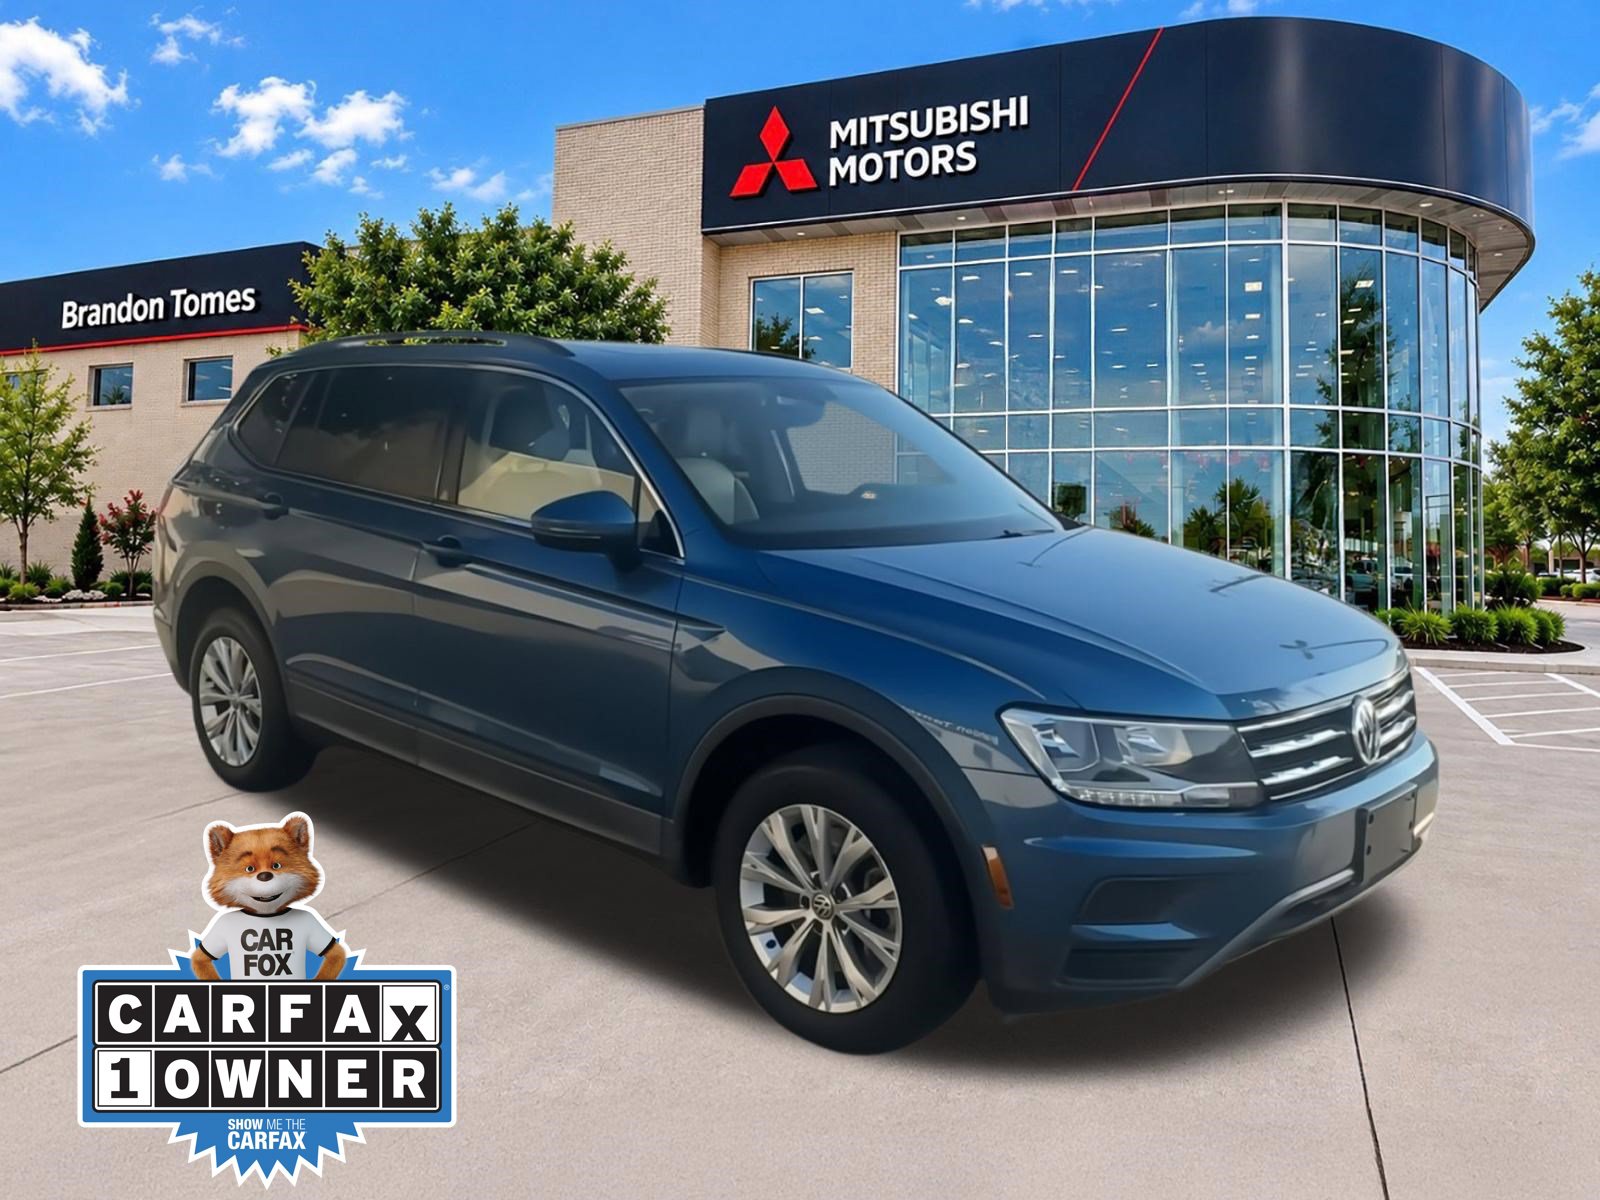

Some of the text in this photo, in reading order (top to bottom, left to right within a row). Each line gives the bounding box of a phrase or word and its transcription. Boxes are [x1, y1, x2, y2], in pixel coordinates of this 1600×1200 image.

[829, 95, 1029, 149] MITSUBISHI
[828, 141, 977, 187] MOTORS
[61, 287, 256, 330] Brandon Tomes
